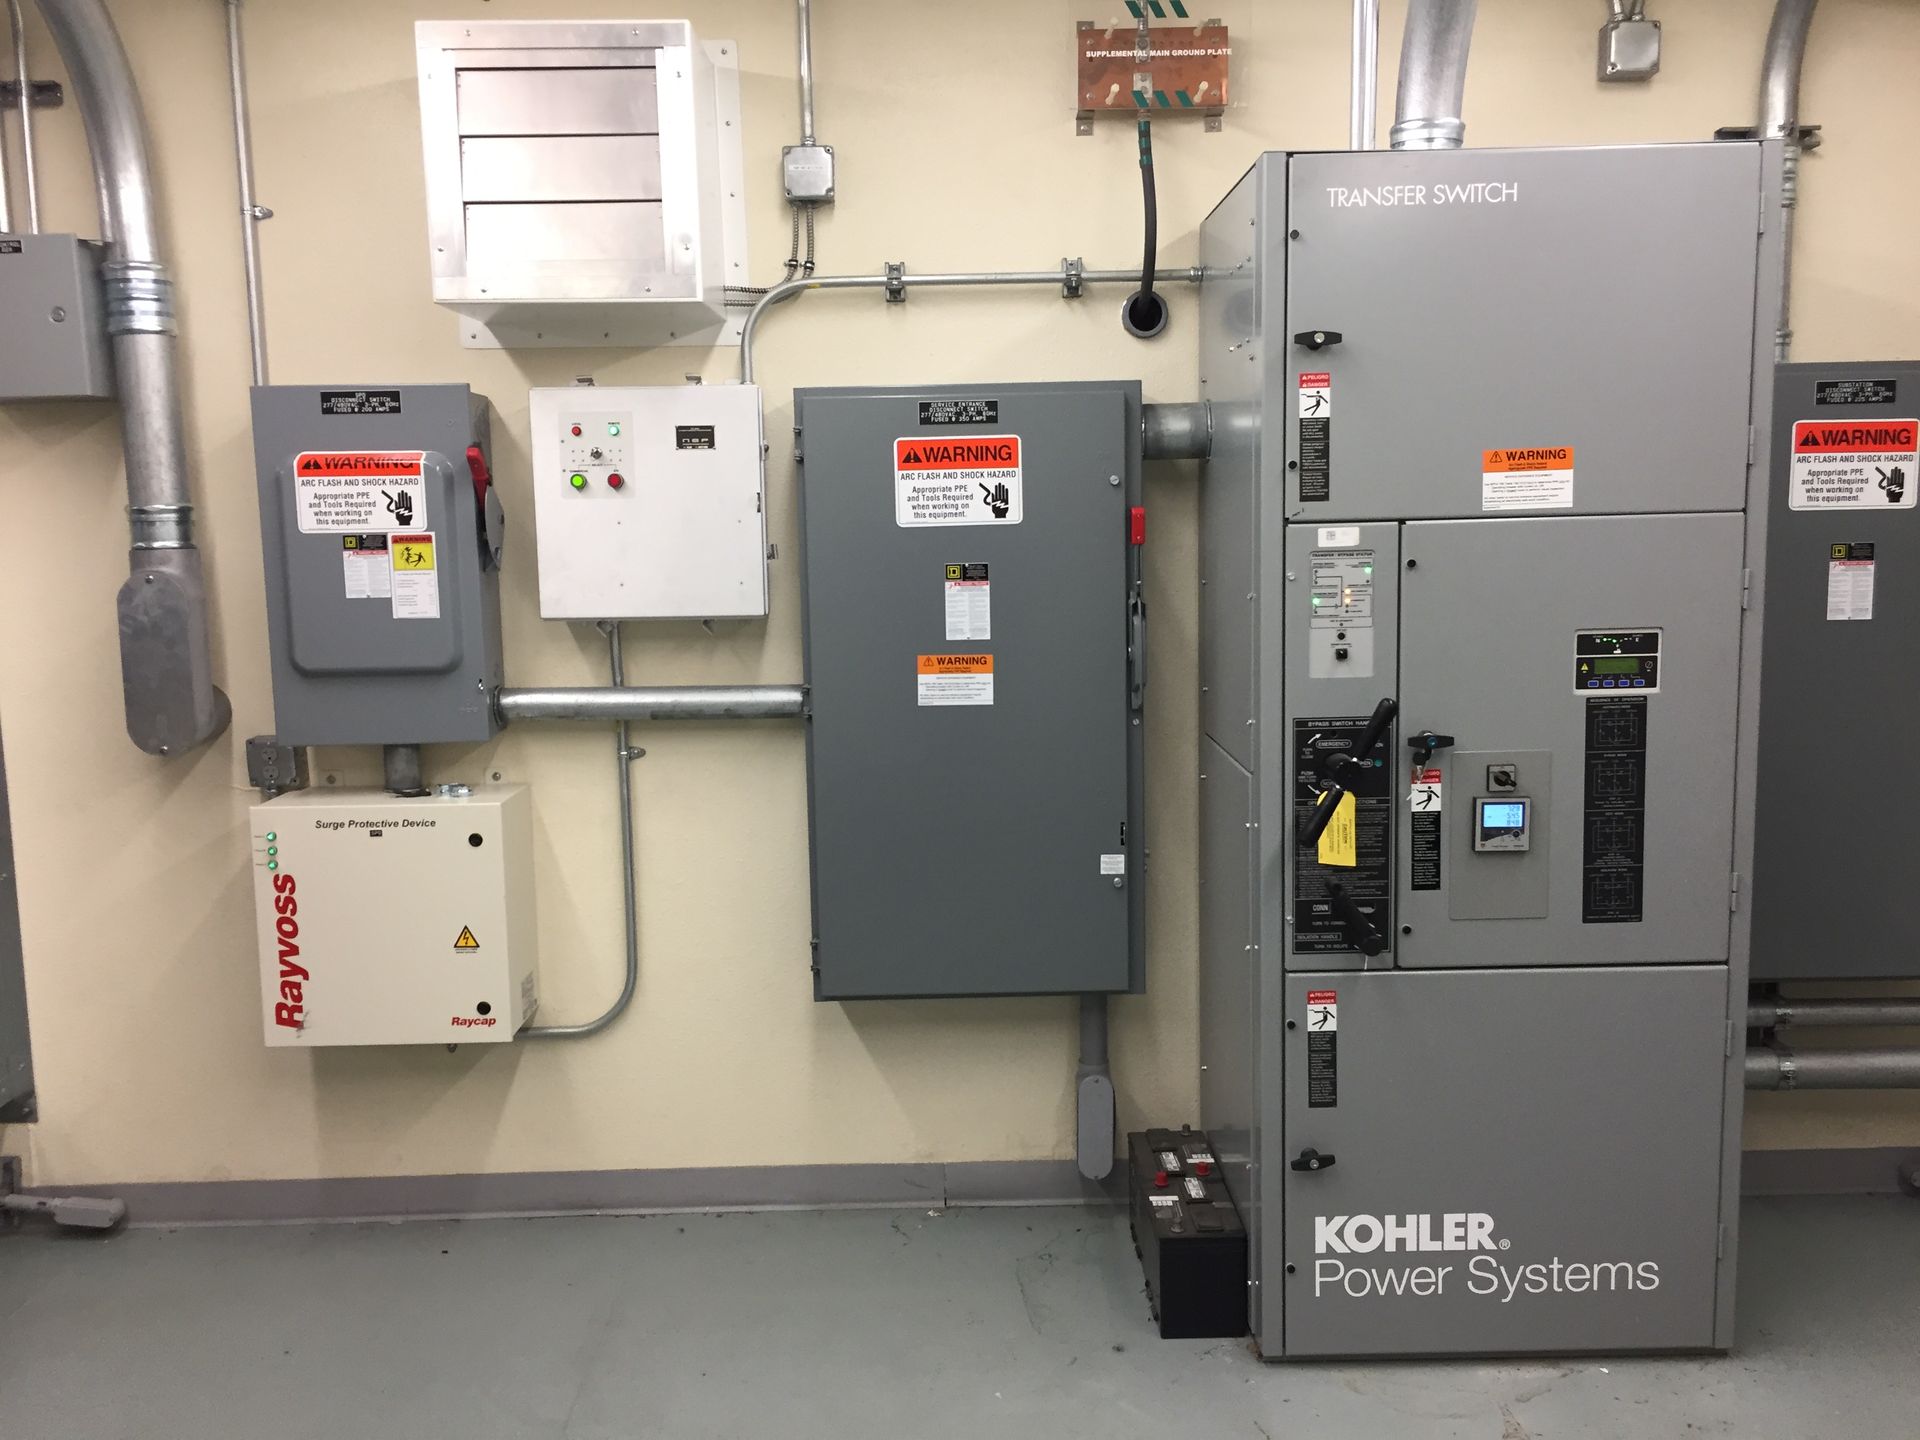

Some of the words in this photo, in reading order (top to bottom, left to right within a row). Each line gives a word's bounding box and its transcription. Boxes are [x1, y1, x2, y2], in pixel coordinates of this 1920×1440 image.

[1327, 185, 1426, 208] TRANSFER
[1432, 182, 1518, 205] SWITCH
[1822, 428, 1911, 446] WARNING
[922, 444, 1012, 462] WARNING
[1506, 449, 1566, 461] WARNING
[324, 456, 414, 469] WARNING
[362, 478, 386, 486] SHOCK
[1837, 477, 1869, 485] Required
[912, 486, 952, 494] Appropriate
[314, 492, 354, 501] Appropriate
[943, 493, 974, 502] Required
[345, 501, 376, 509] Required
[932, 503, 960, 511] working
[334, 509, 362, 518] working
[928, 511, 966, 519] equipment.
[936, 656, 988, 665] WARNING
[315, 820, 345, 830] Surge
[348, 819, 399, 828] Protective
[402, 818, 436, 827] Device
[273, 874, 309, 1030] Rayvoss
[452, 1017, 496, 1027] Raycap
[1315, 1259, 1454, 1298] Power
[1467, 1256, 1660, 1303] Systems
